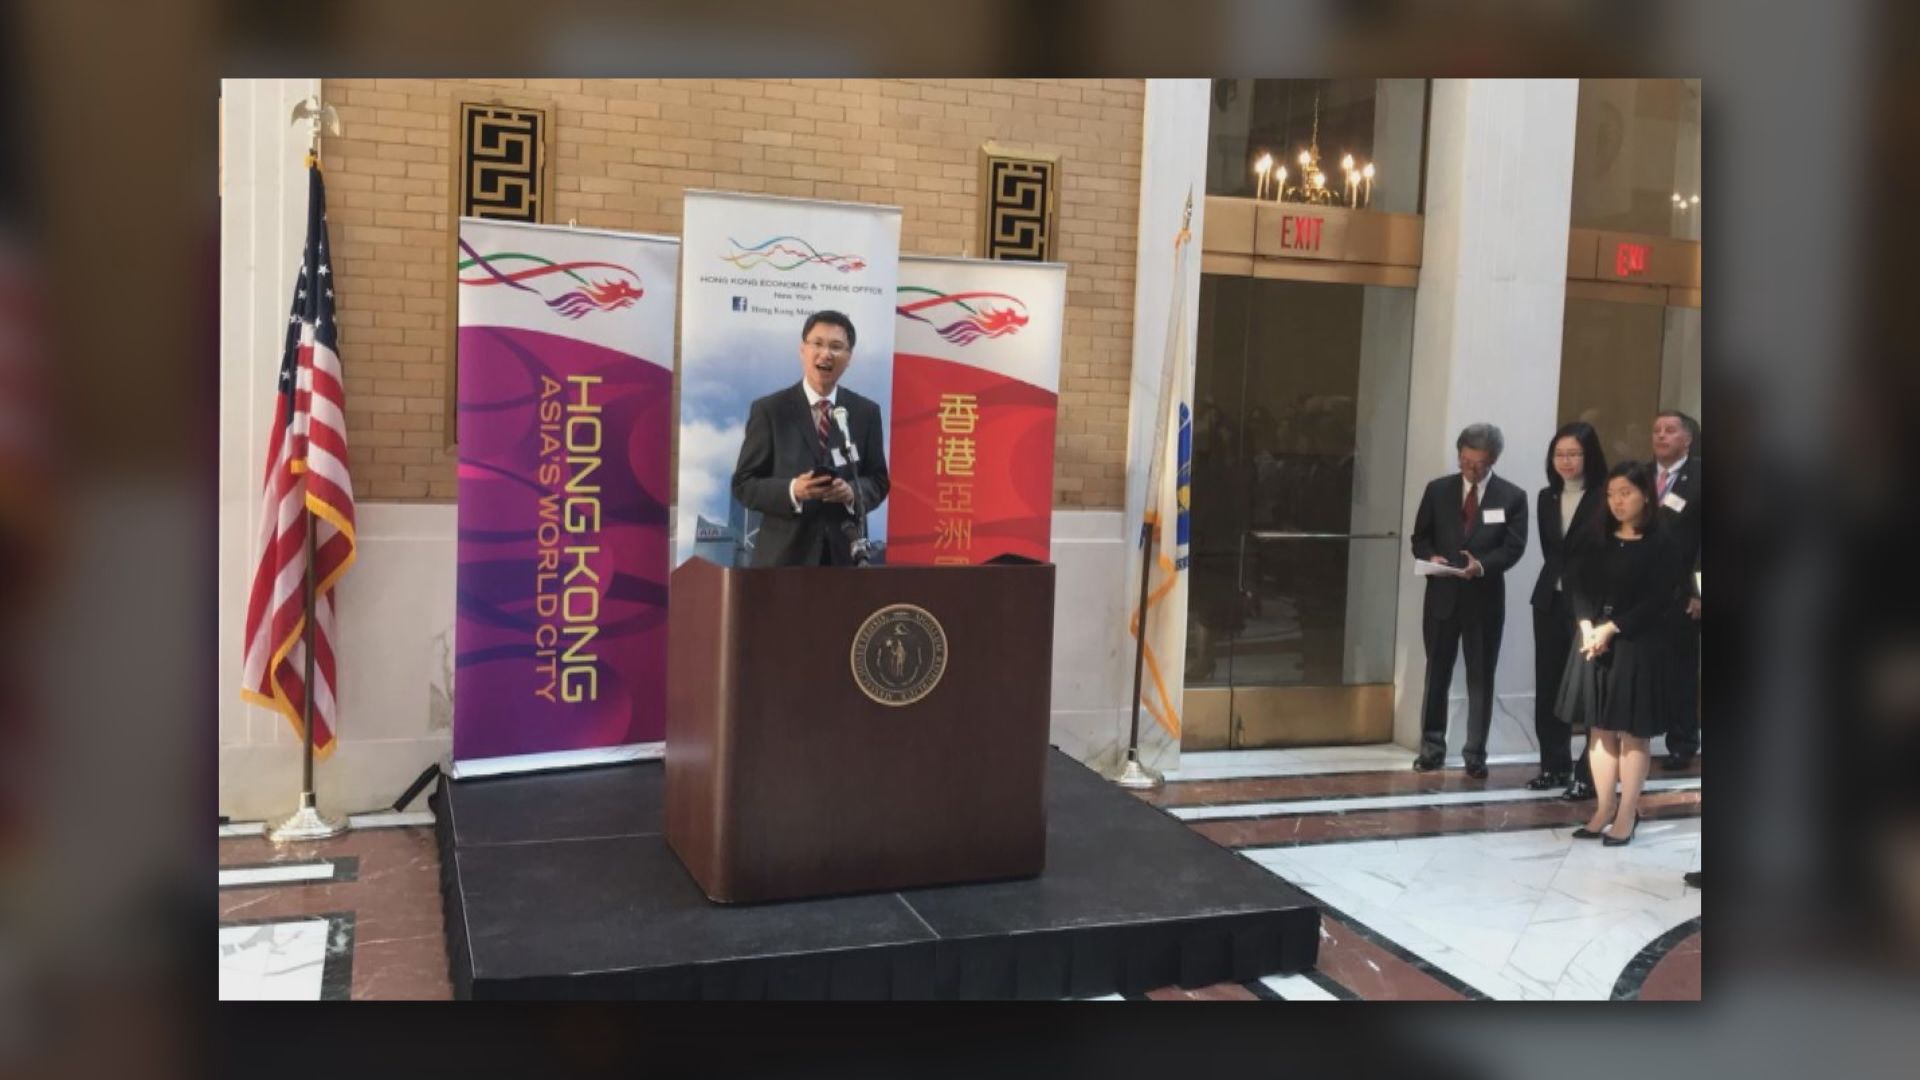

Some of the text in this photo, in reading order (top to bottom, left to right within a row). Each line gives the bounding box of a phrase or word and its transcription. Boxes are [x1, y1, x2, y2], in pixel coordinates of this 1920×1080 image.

[1281, 216, 1325, 251] EXIT
[700, 276, 883, 295] HONG KONG ECONOMIC & TRADE OFFICE
[774, 291, 813, 301] New York
[752, 306, 773, 316] Hong
[774, 307, 794, 317] Kong
[534, 375, 562, 704] ASIA'S WORLD CITY
[561, 375, 602, 703] HONG KONG
